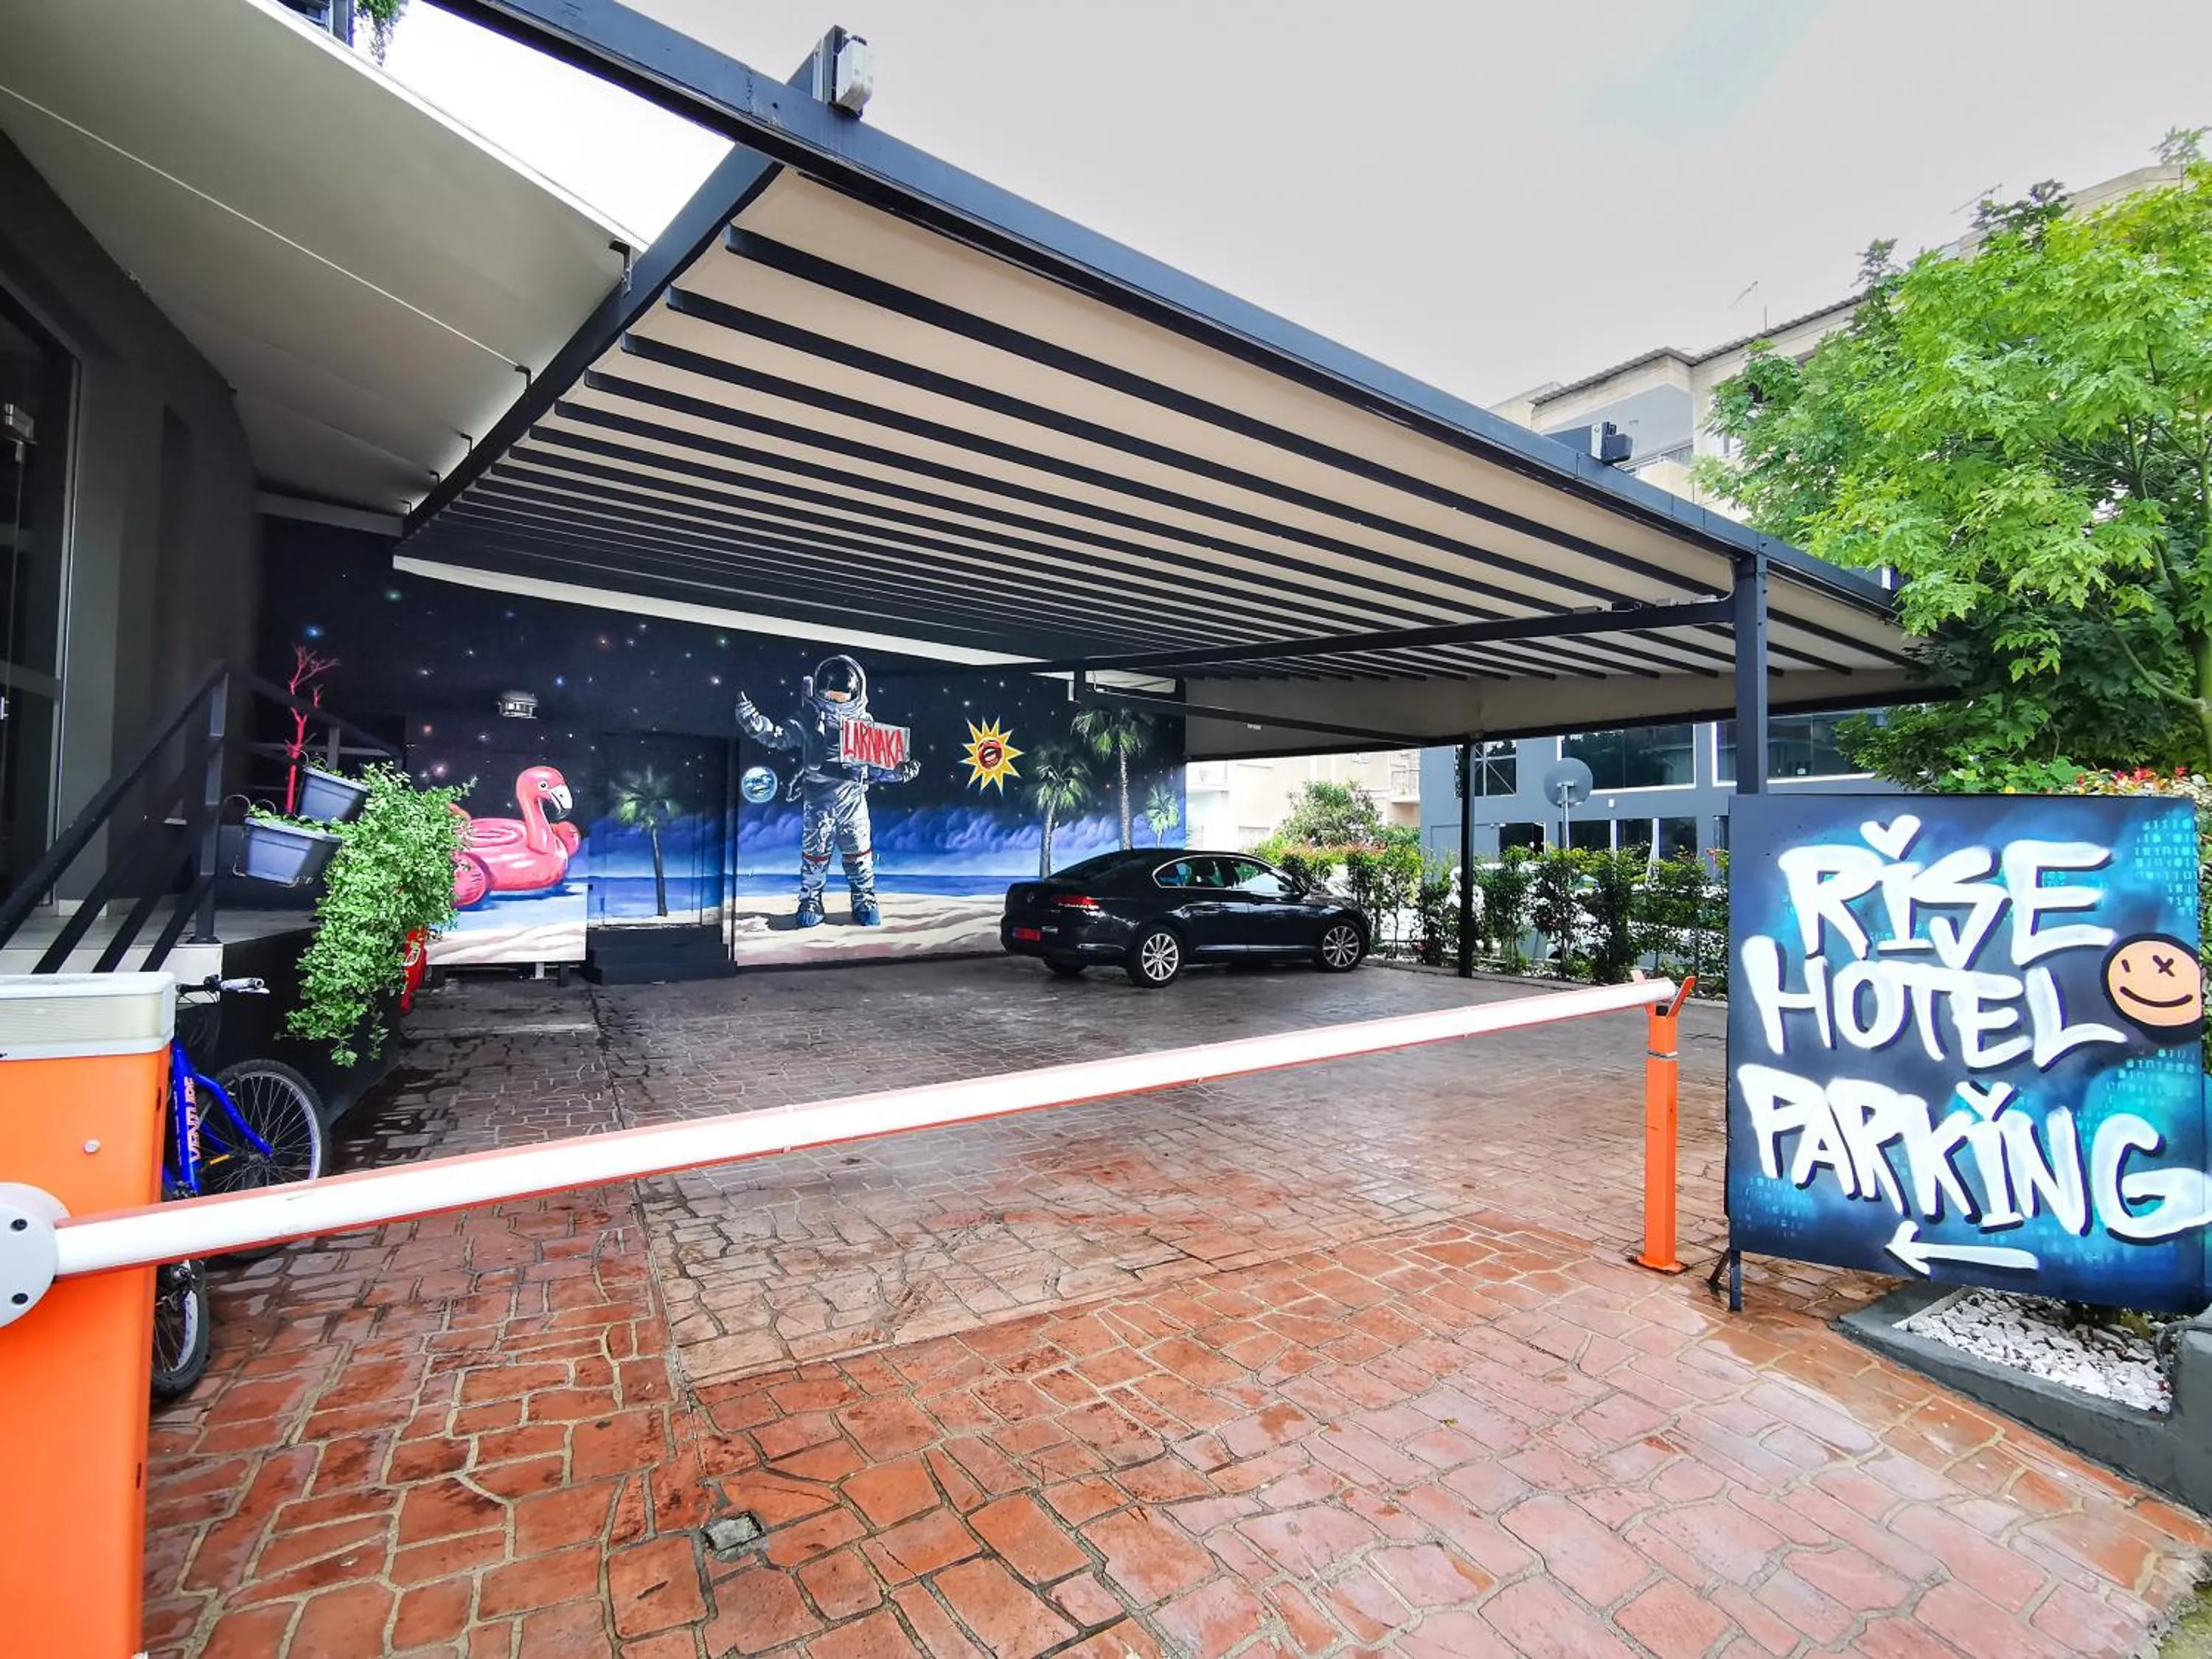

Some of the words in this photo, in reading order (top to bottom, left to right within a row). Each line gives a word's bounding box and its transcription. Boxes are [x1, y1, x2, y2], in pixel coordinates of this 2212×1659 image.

[843, 720, 905, 768] LARNAKA
[1778, 815, 2118, 970] RISE
[1741, 936, 2128, 1074] HOTEL
[1737, 1064, 2212, 1244] PARKING
